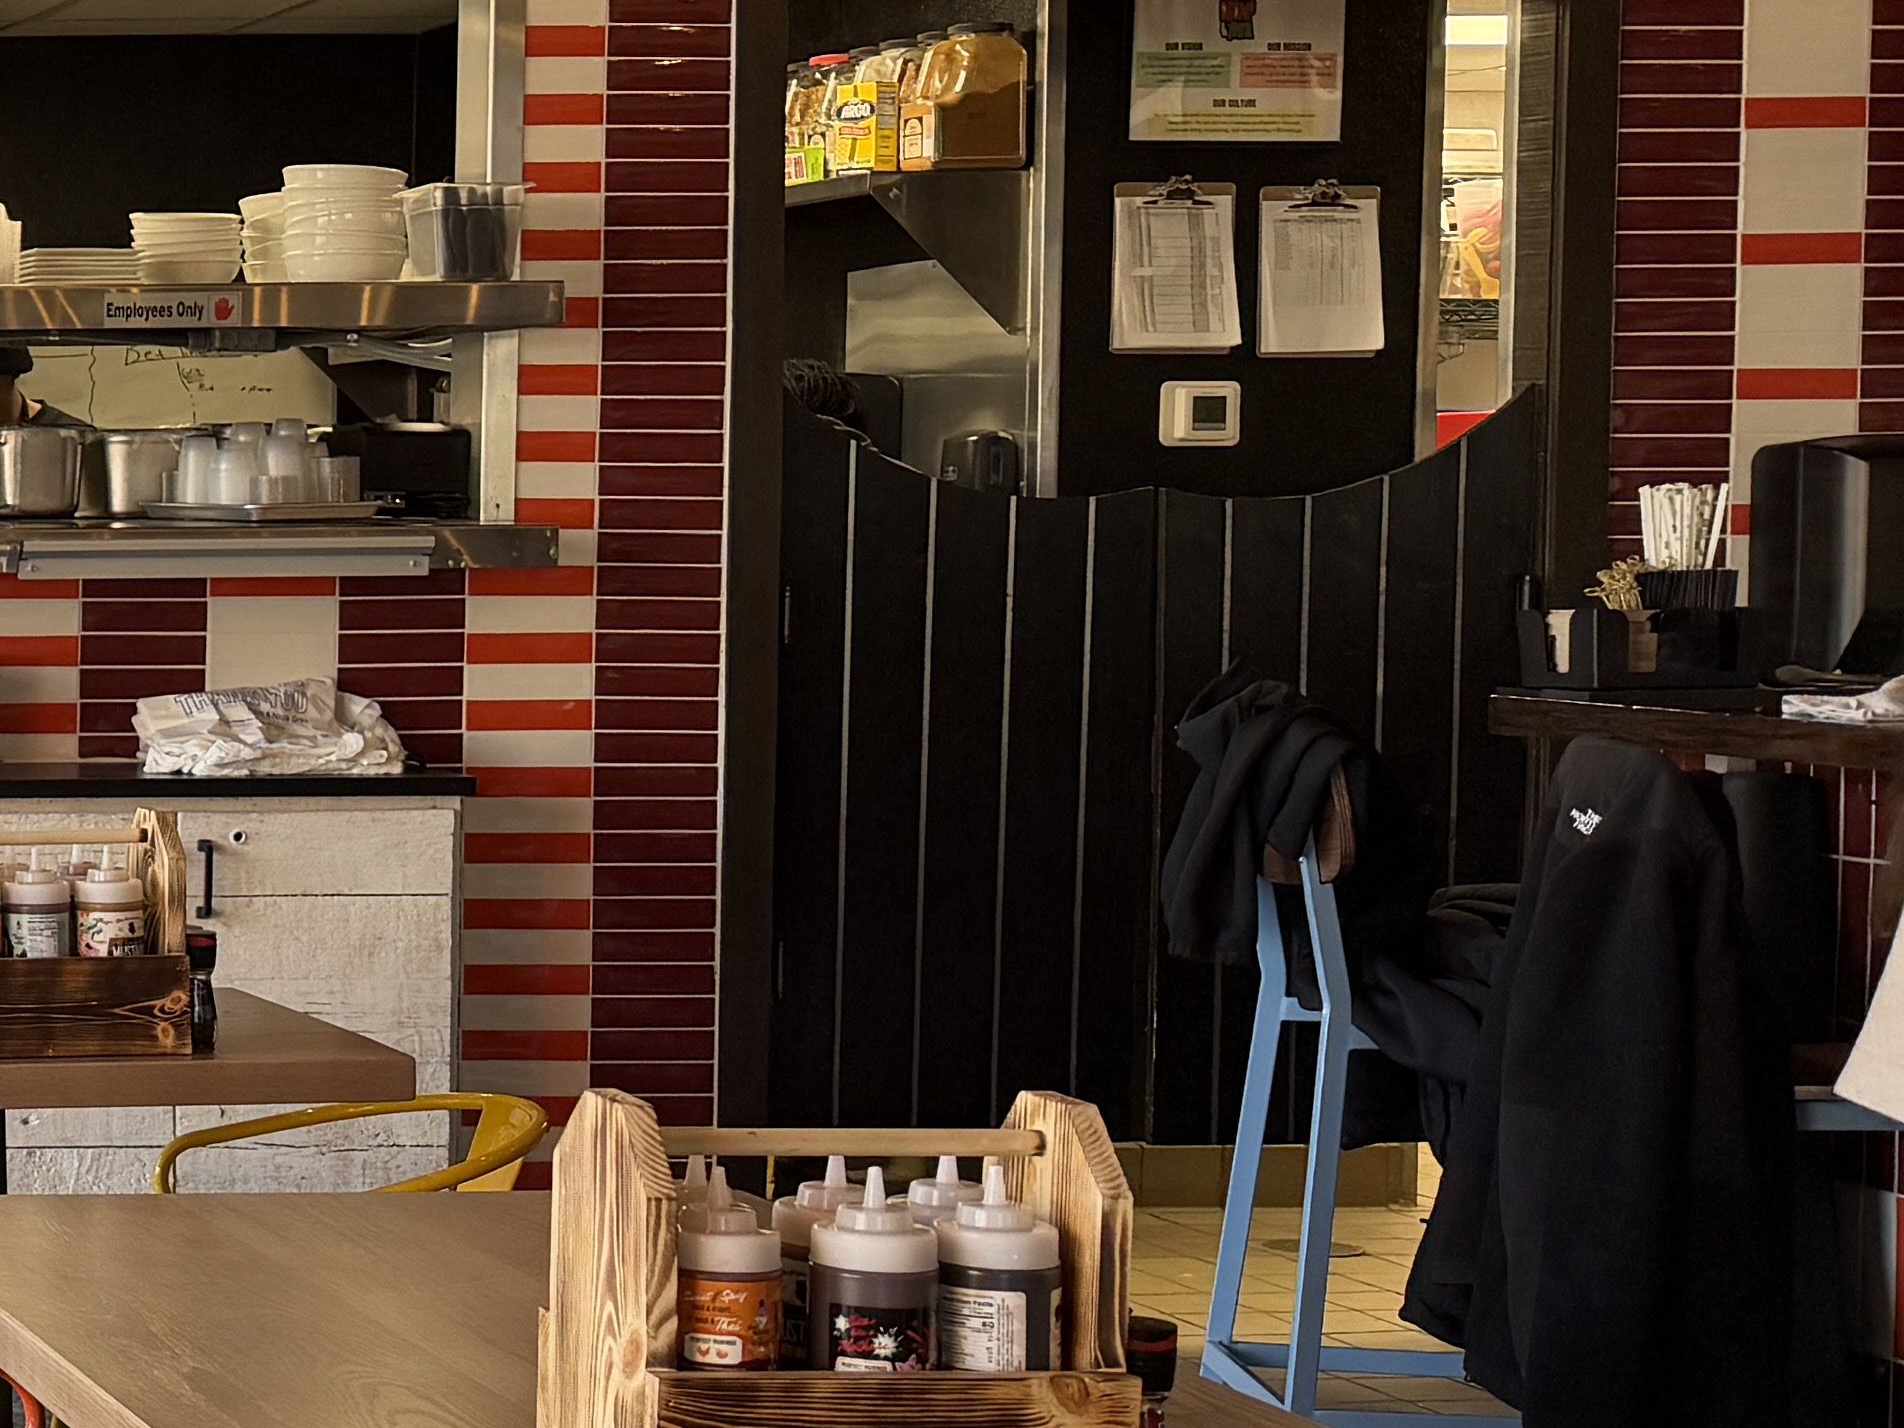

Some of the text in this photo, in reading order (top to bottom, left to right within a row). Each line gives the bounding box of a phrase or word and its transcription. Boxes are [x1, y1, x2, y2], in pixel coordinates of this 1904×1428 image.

[840, 101, 871, 120] ARGO
[106, 301, 204, 321] Employees Only
